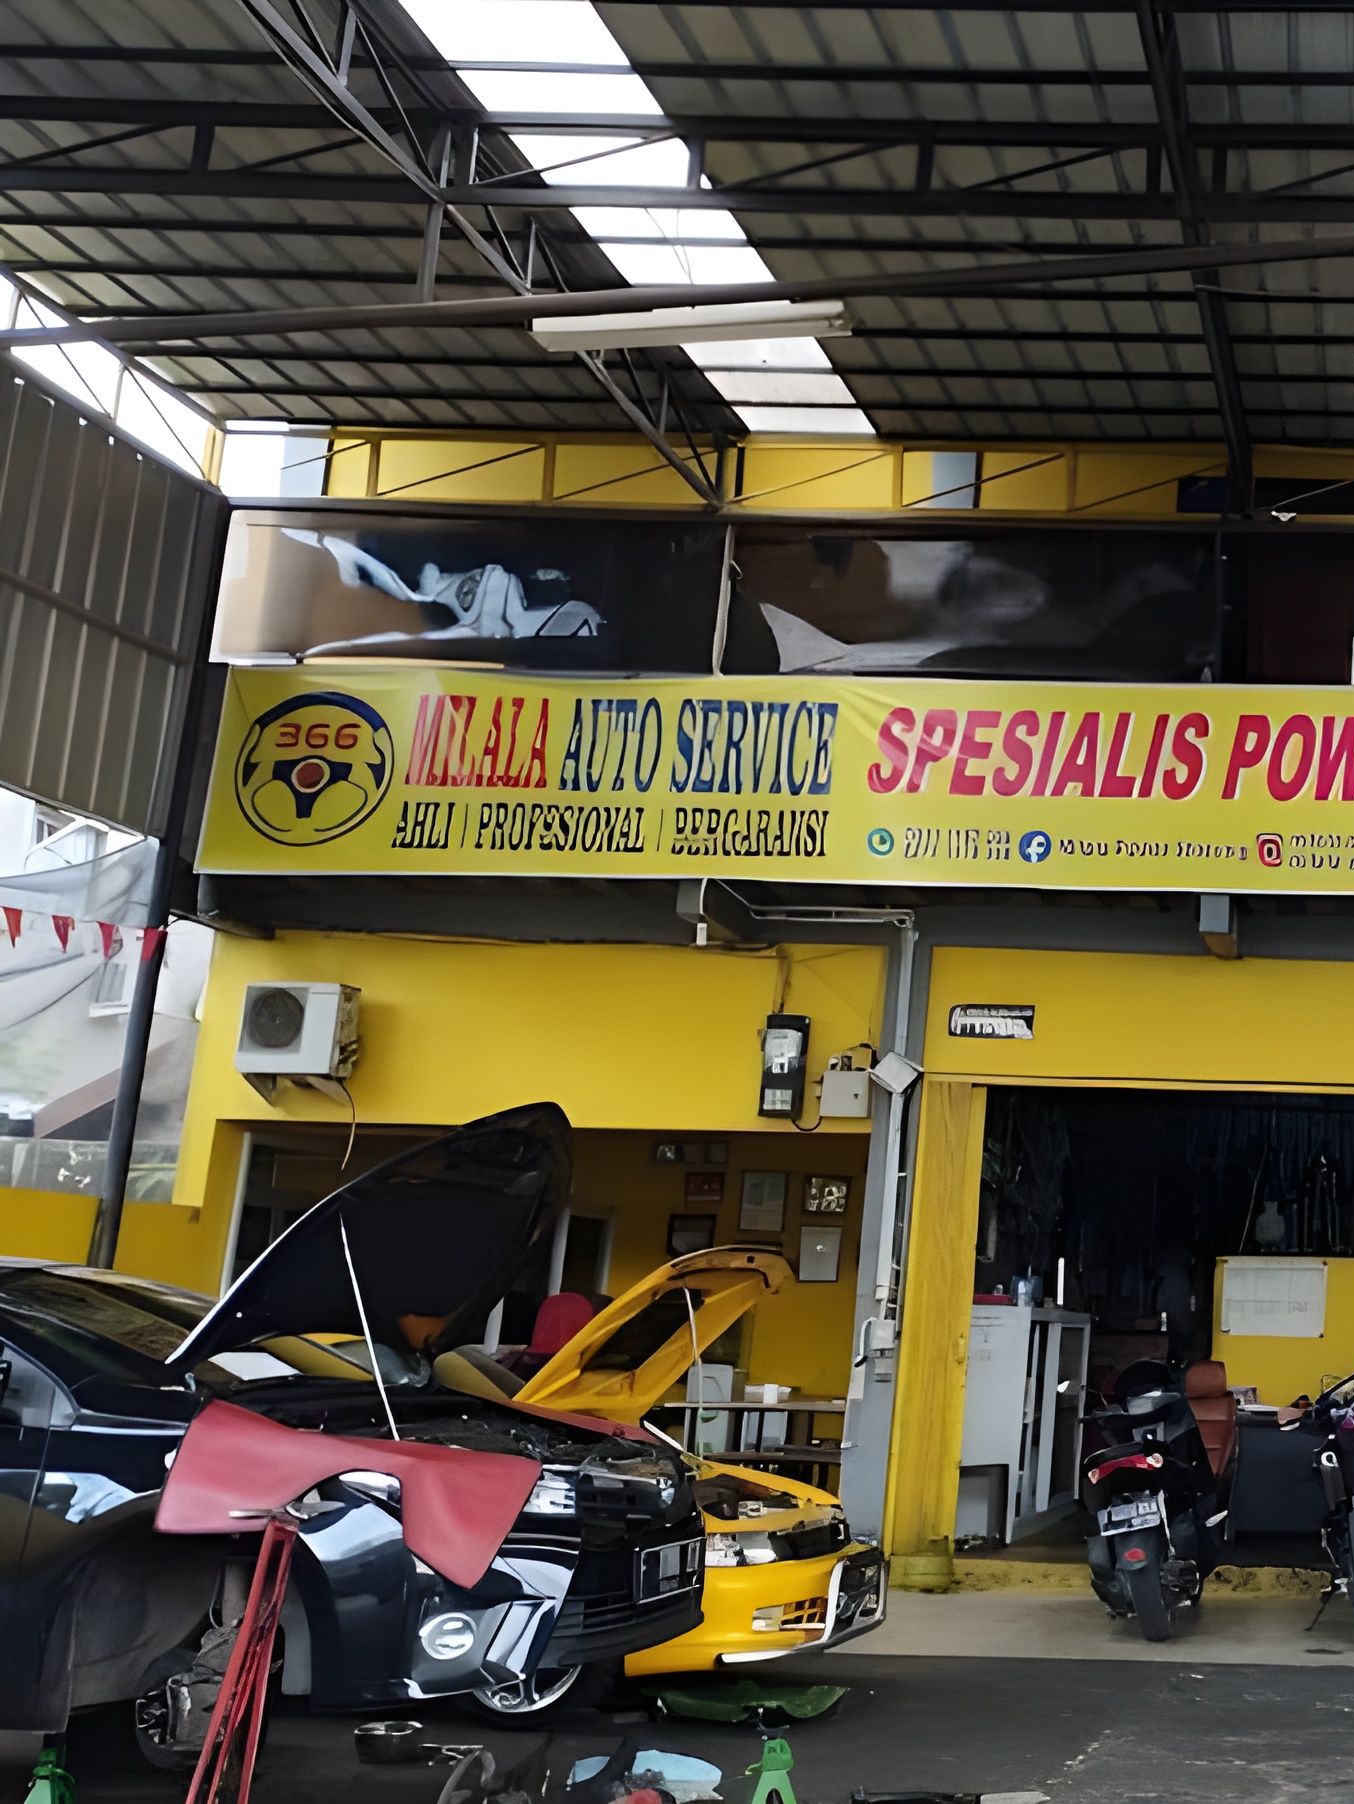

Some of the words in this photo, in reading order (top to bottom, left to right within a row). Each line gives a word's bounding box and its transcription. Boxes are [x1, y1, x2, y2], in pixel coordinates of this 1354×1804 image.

[275, 723, 361, 749] 366
[559, 698, 662, 792] AUTO
[671, 699, 839, 795] SERVICE
[868, 708, 1210, 801] SPESIALIS
[391, 801, 456, 849] AHLI
